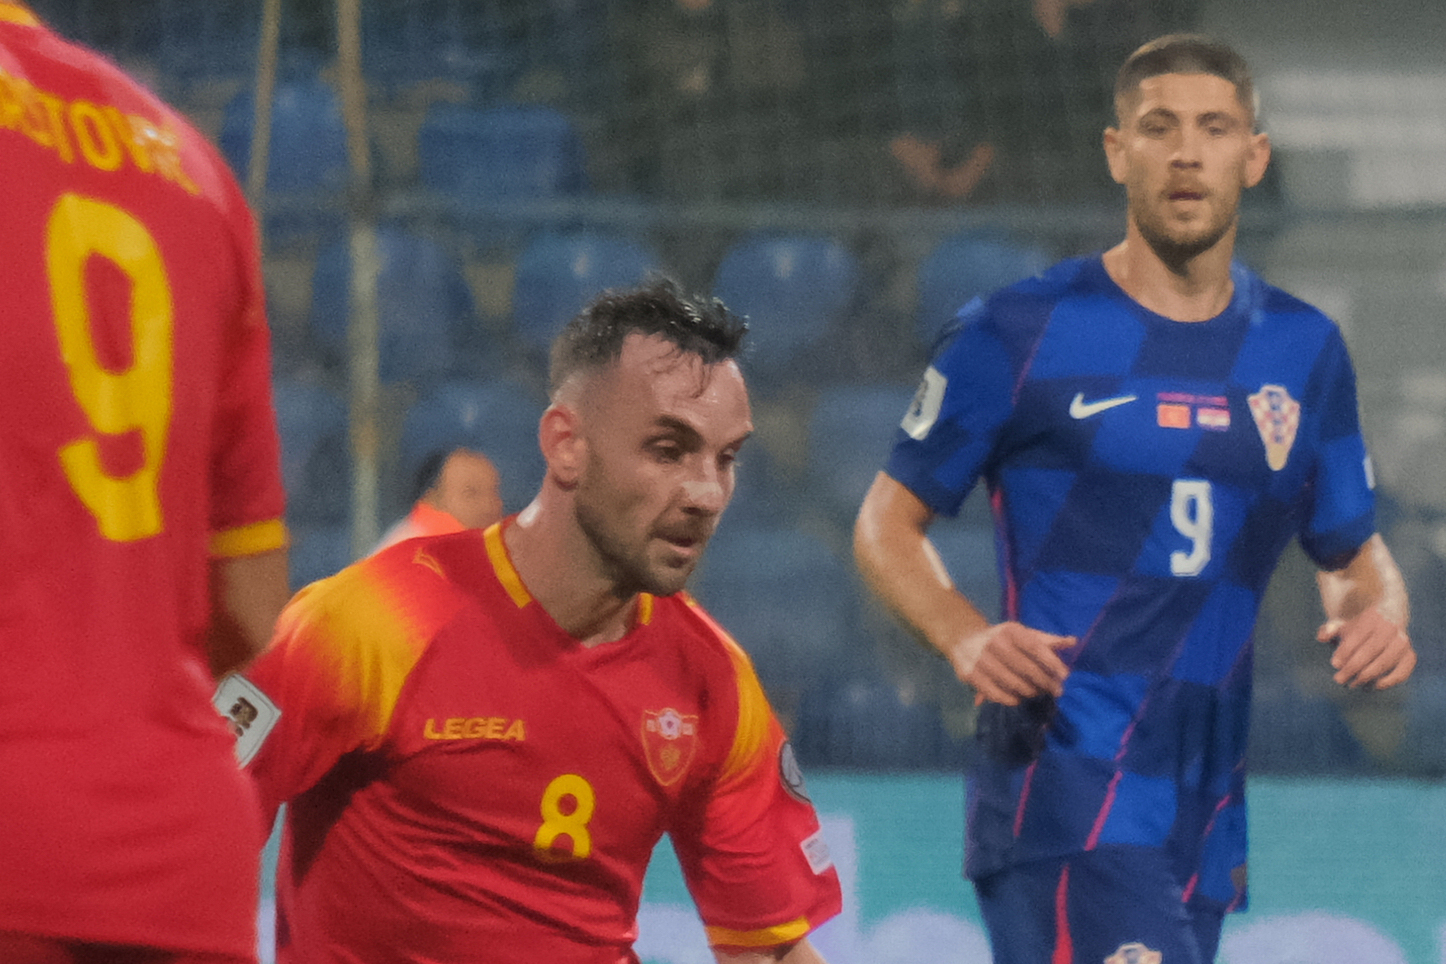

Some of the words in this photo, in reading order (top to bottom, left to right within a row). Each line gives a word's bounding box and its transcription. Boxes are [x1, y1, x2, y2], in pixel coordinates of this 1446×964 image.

[45, 192, 175, 542] 9
[1169, 479, 1214, 577] 9
[424, 717, 526, 741] LEGEA
[533, 774, 596, 862] 8
